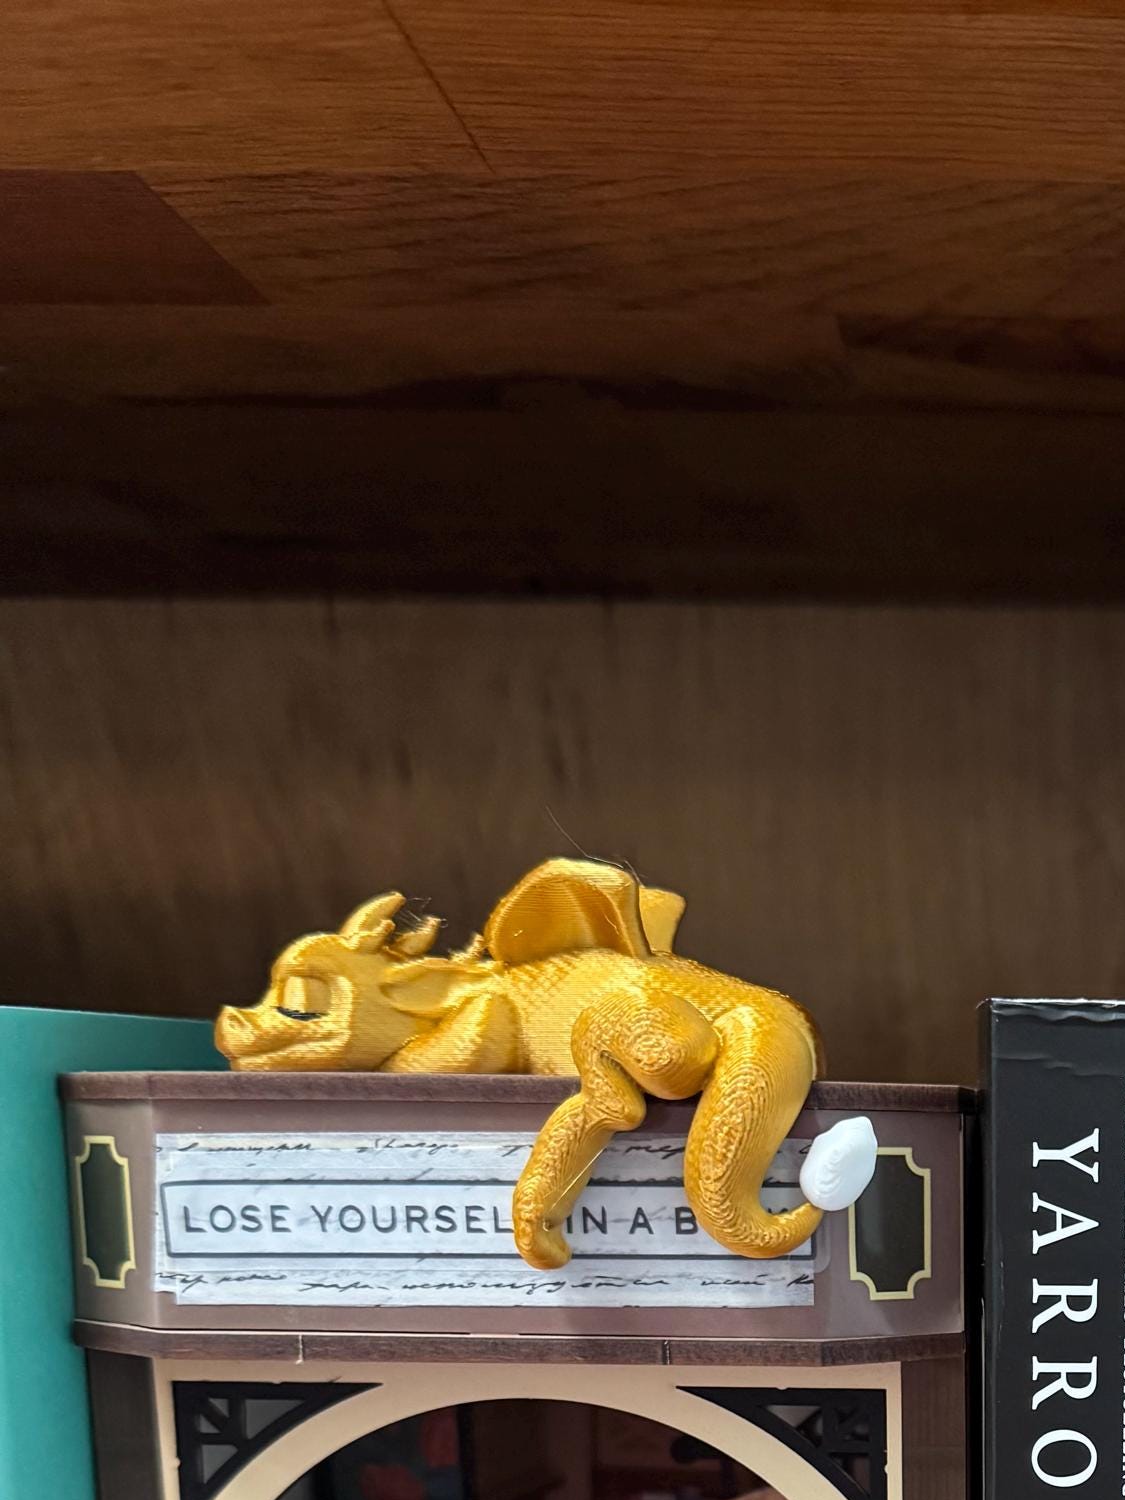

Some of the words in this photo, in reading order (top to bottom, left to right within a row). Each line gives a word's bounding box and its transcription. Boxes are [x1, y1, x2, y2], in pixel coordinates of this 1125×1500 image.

[183, 1204, 292, 1234] LOSE
[310, 1204, 516, 1234] YOURSEL
[629, 1206, 654, 1235] A
